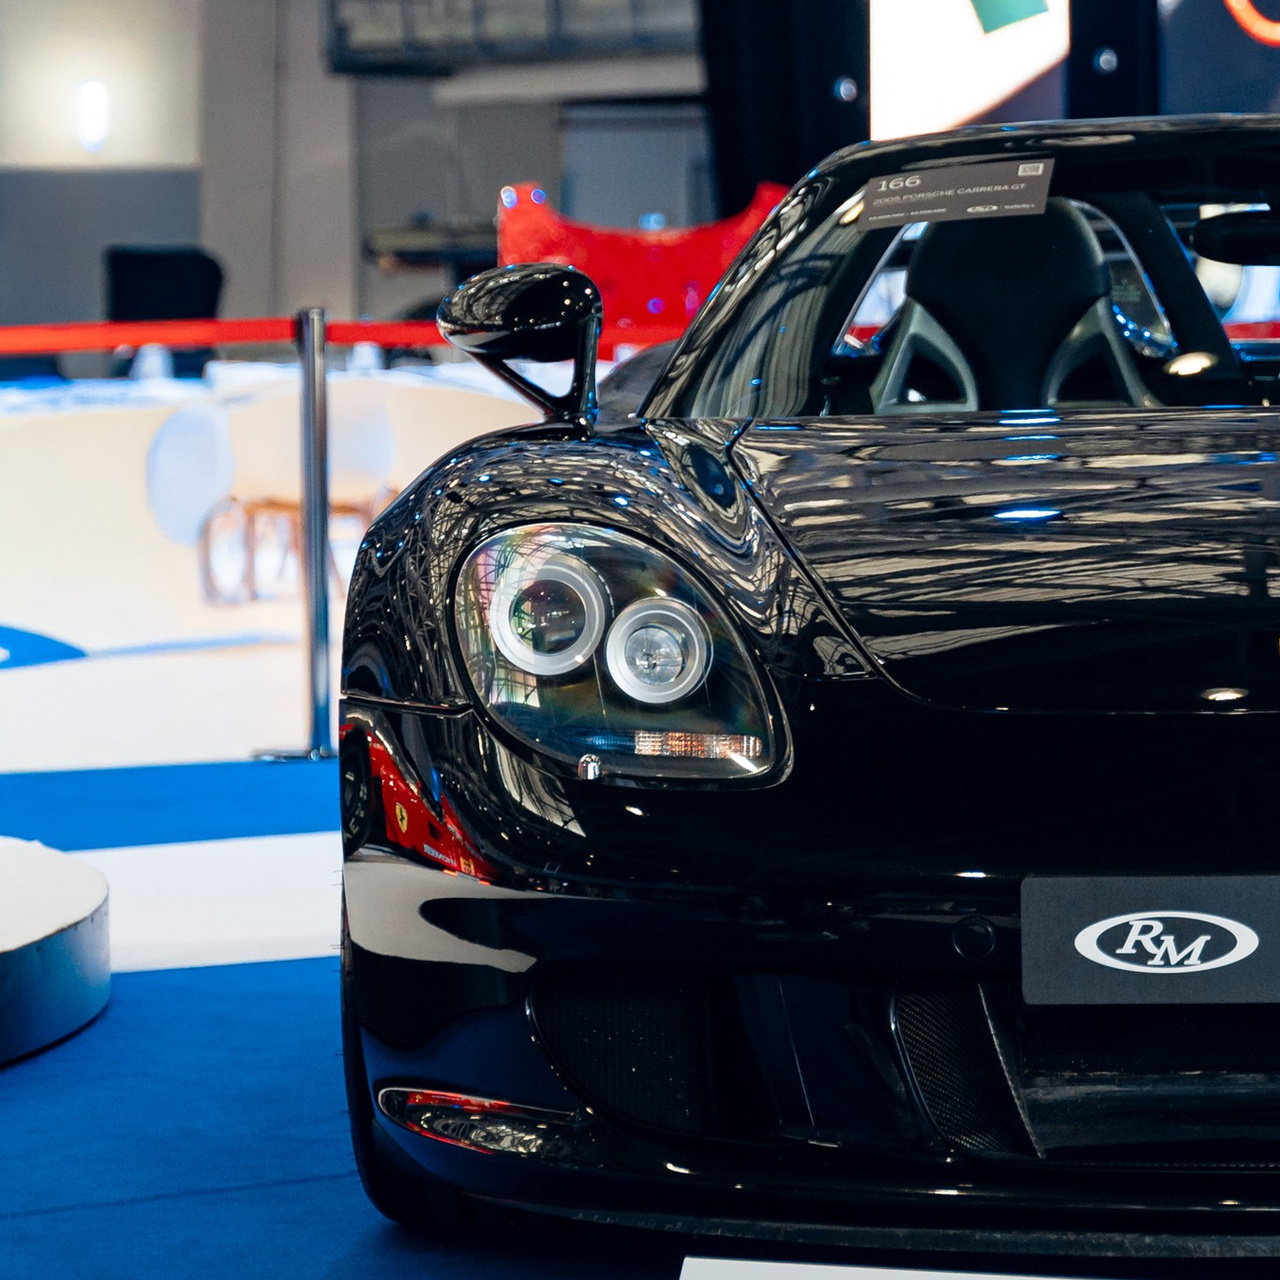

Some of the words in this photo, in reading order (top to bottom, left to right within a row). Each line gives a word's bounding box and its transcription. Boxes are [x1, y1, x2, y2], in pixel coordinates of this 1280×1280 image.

[876, 175, 922, 192] 166
[902, 189, 955, 204] PORSCHE
[956, 184, 1010, 195] CARRERA
[1010, 183, 1028, 191] GT
[1116, 920, 1211, 966] RM
